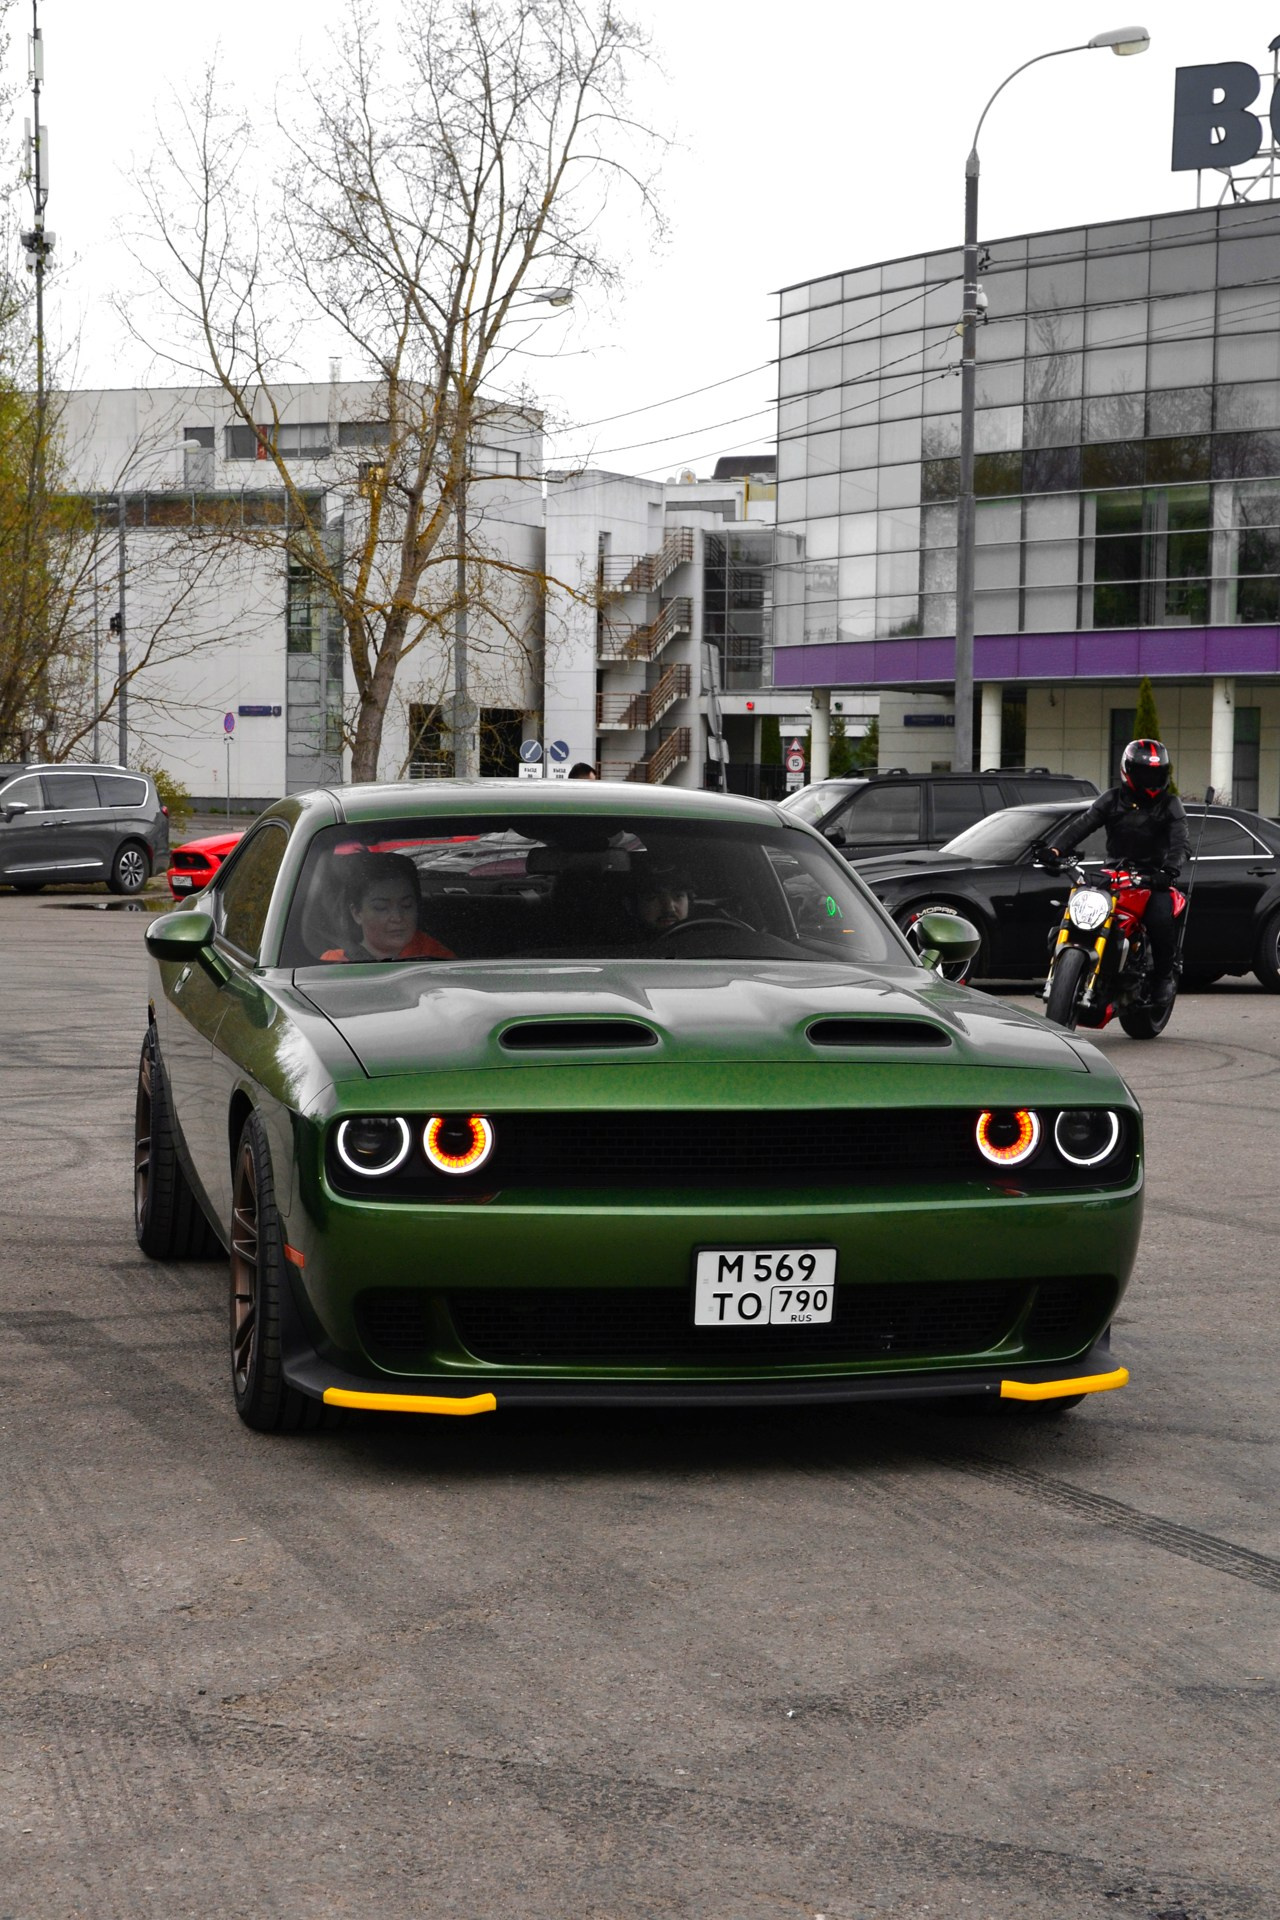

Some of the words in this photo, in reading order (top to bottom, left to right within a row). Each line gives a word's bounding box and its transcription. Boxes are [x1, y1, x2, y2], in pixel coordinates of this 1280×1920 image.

[791, 759, 799, 767] 15
[916, 906, 957, 918] MOPAR
[712, 1292, 762, 1320] TO
[779, 1289, 828, 1312] 790
[790, 1314, 812, 1322] RUS
